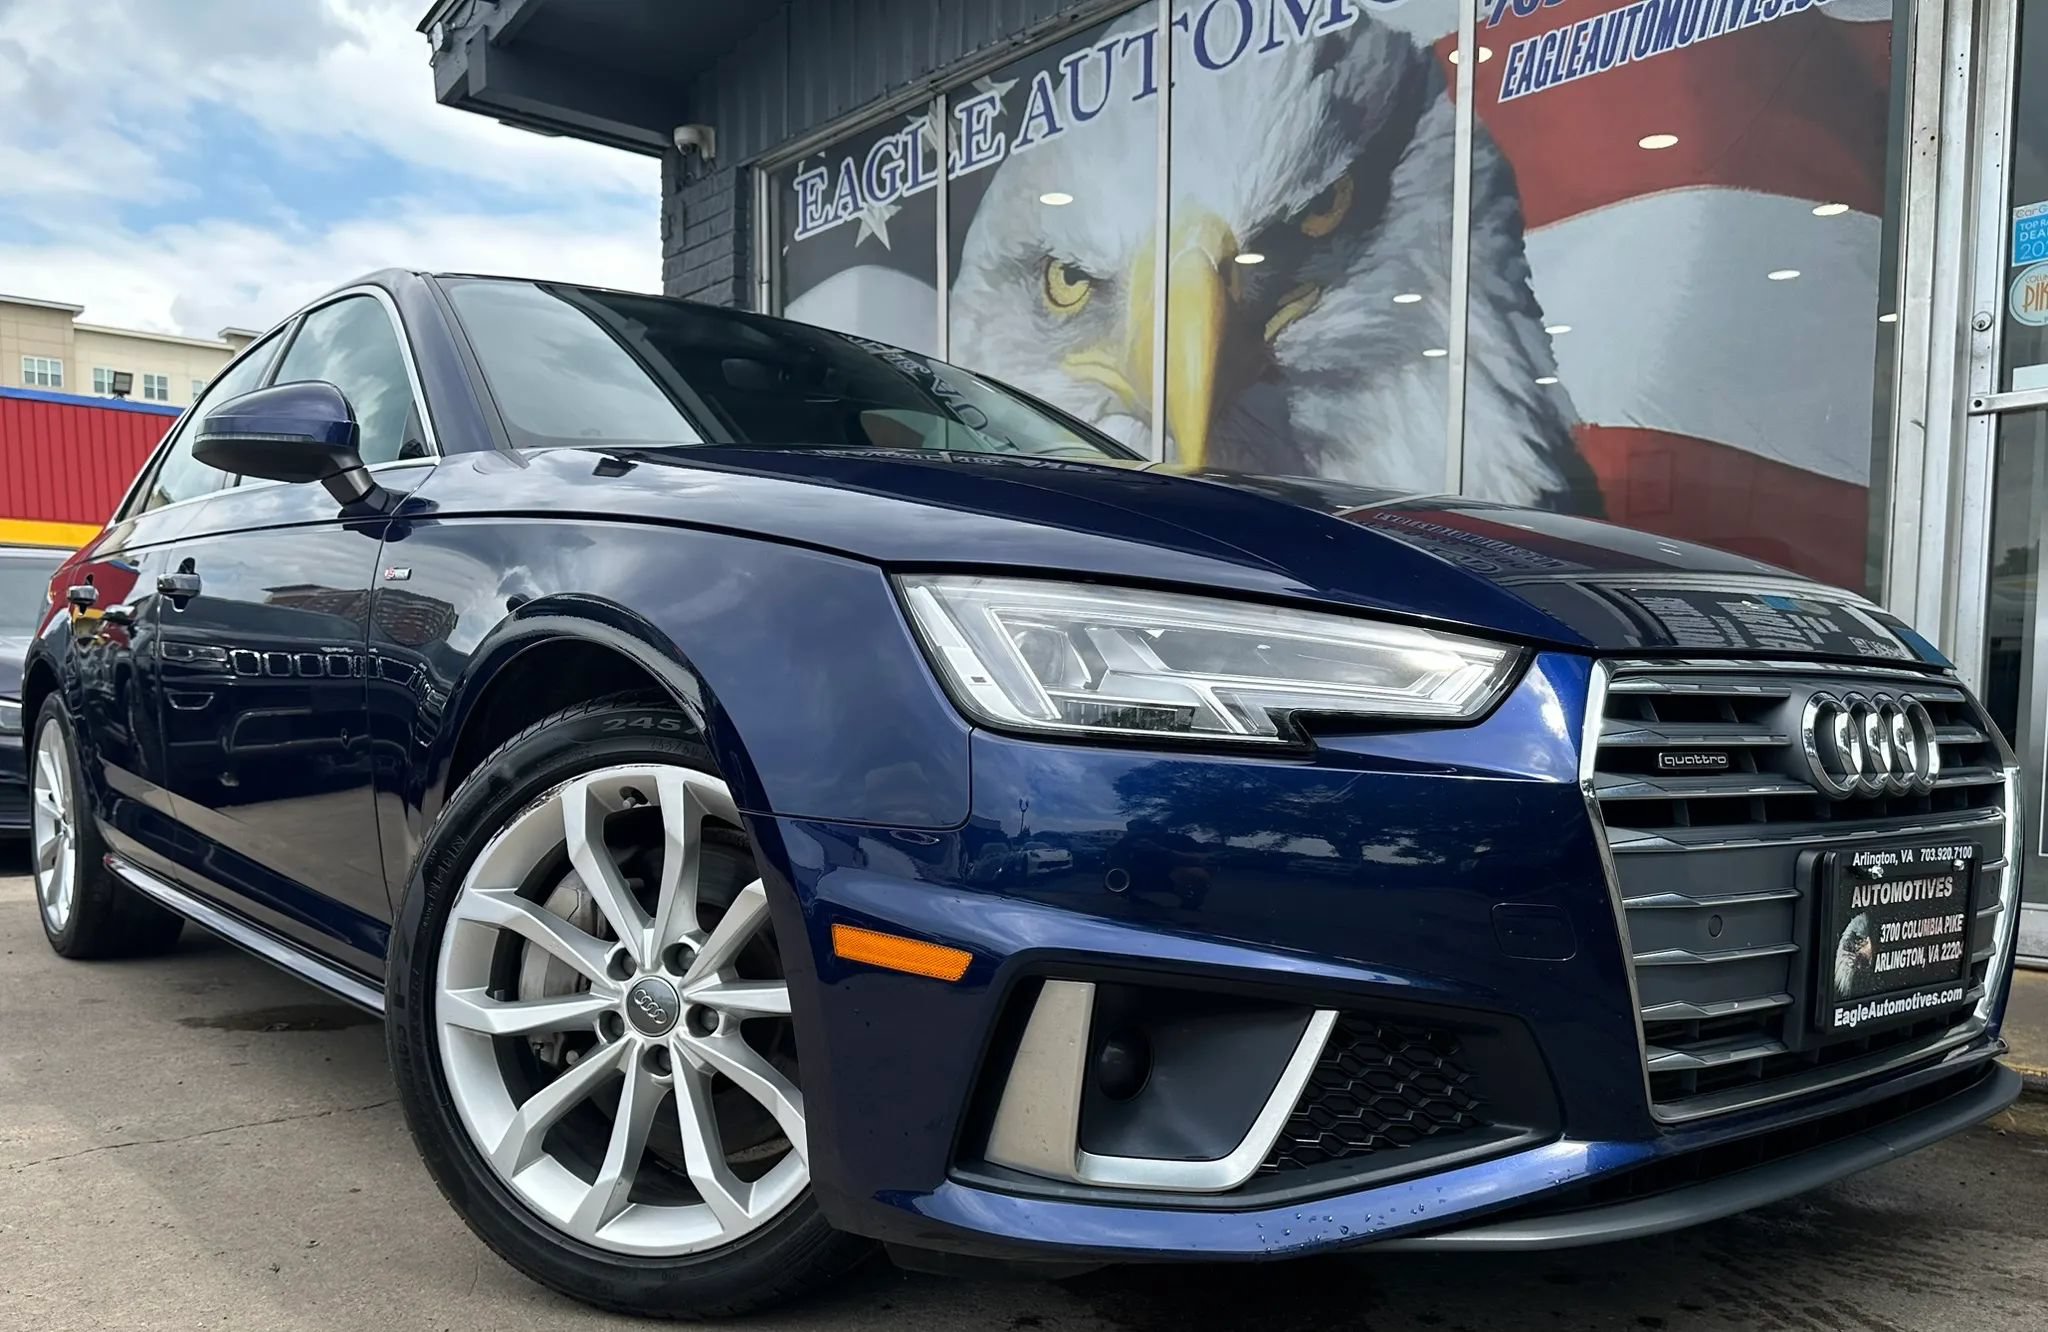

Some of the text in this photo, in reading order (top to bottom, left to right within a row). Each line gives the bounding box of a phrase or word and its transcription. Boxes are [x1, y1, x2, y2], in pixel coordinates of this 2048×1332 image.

[794, 91, 1005, 241] EAGLE
[2020, 221, 2038, 230] TOP
[1664, 754, 1727, 767] quattro
[1852, 846, 1973, 868] Arlington, VA 703.920.7100
[1851, 876, 1953, 908] AUTOMOTIVES
[1880, 913, 1965, 943] 3700 COLUMBIA PIKE
[1874, 946, 1926, 973] ARLINGTON,
[1928, 944, 1940, 963] VA
[1834, 987, 1963, 1028] EagleAutomotives.com
